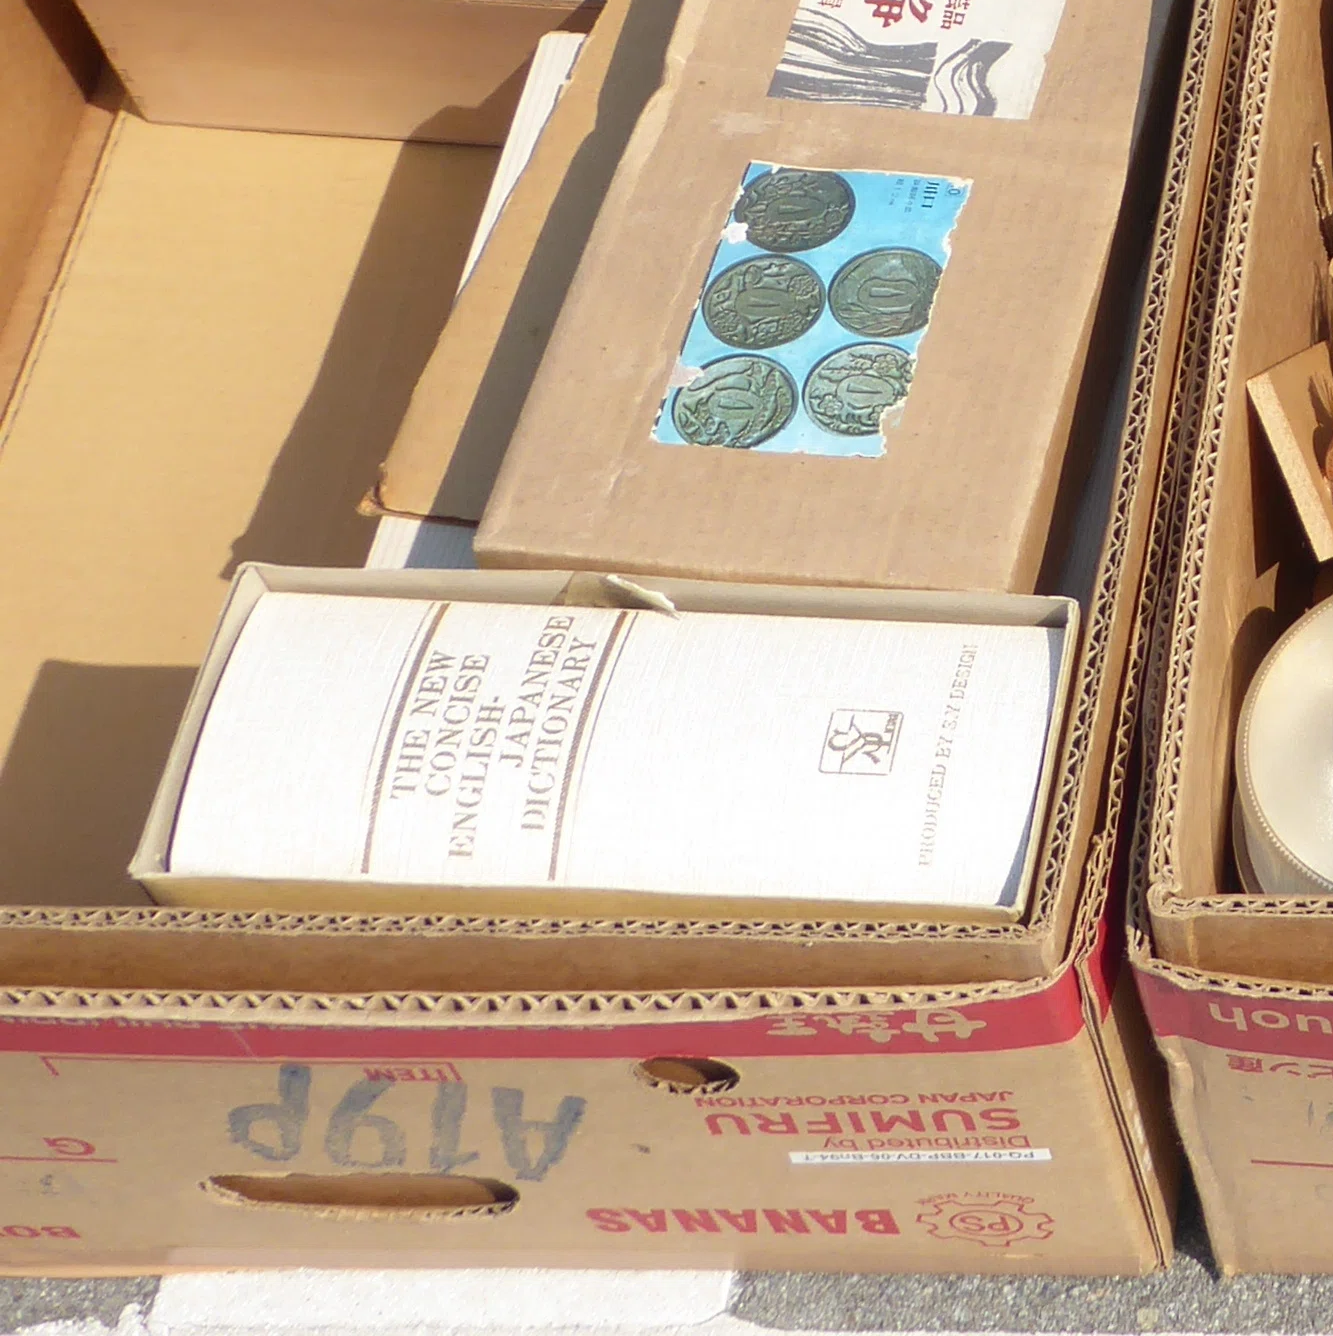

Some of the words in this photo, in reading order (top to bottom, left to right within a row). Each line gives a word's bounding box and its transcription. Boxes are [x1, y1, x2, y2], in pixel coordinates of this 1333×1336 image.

[408, 649, 458, 717] NEW
[497, 614, 574, 769] JAPANESE
[423, 653, 491, 798] CONCISE
[520, 636, 598, 832] DICTIONARY
[388, 728, 432, 801] THE
[917, 763, 948, 867] PRODUCED
[934, 734, 954, 759] BY
[948, 644, 979, 700] DESIGN
[447, 695, 506, 860] ENGLISH-
[362, 1066, 448, 1084] ITEM
[693, 1092, 910, 1110] CORPORATION
[910, 1089, 1016, 1104] JAPAN
[224, 1062, 588, 1185] A19P
[703, 1105, 1021, 1137] SUMIFRU
[41, 1135, 97, 1158] G
[822, 1134, 858, 1152] by
[861, 1133, 1031, 1150] Distributed
[0, 1224, 82, 1240] BO
[584, 1206, 901, 1237] BANANAS
[955, 1212, 1011, 1235] PS
